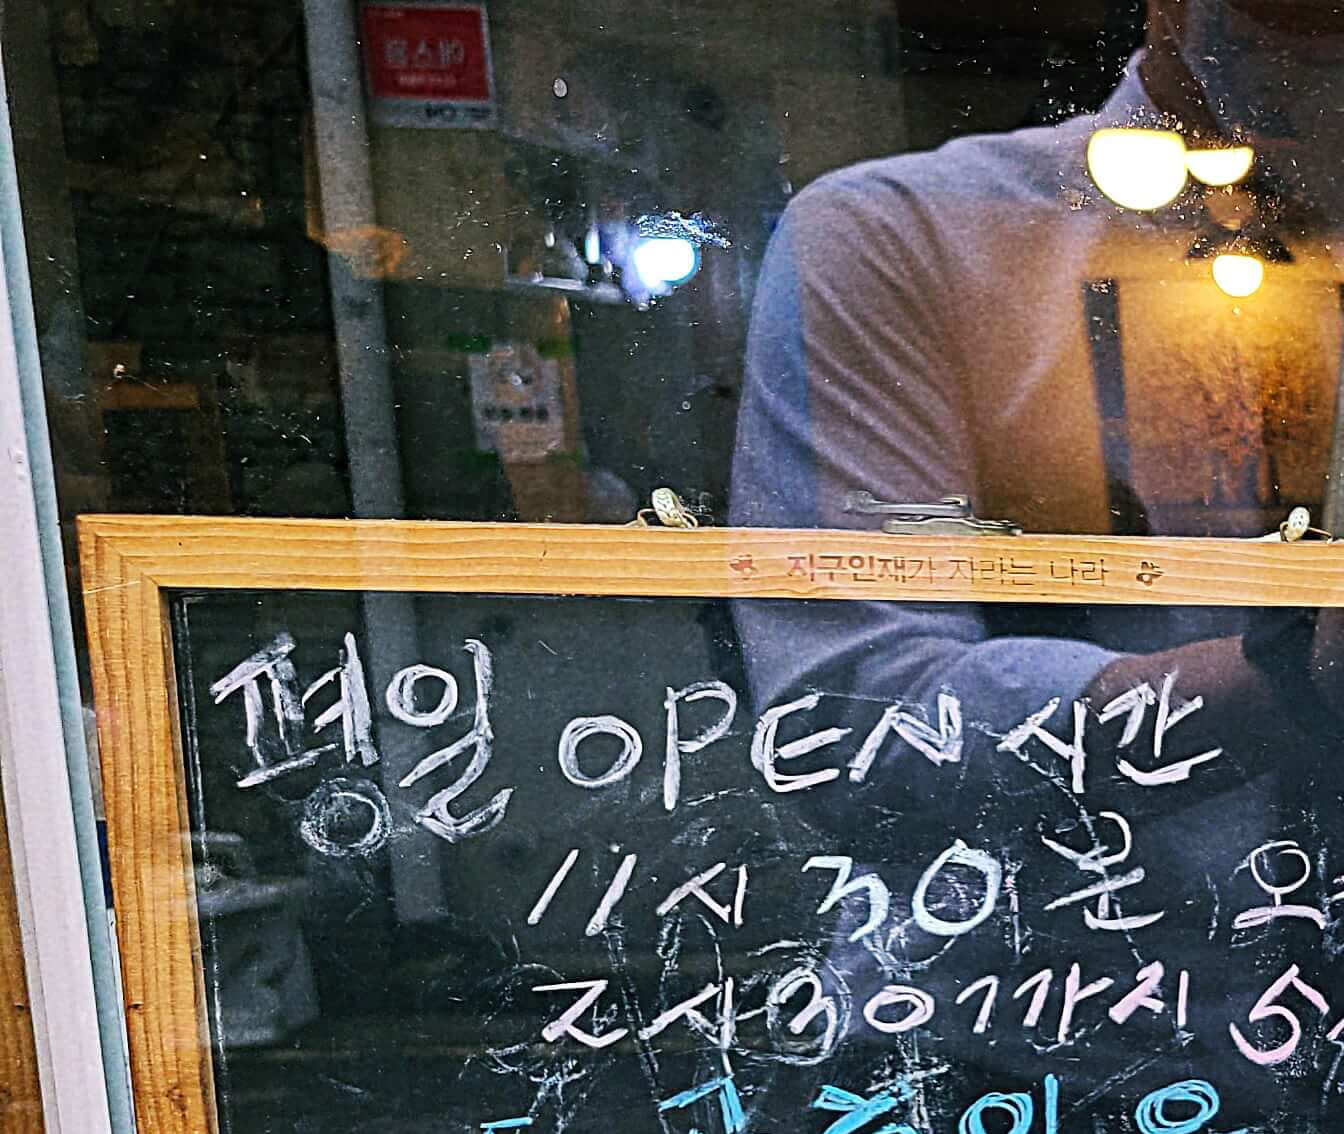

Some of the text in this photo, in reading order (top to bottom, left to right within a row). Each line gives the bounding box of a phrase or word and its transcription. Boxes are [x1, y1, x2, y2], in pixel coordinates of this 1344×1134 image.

[786, 555, 1109, 587] 지구인재가 자라는 나라
[210, 632, 1223, 860] 평일 OPEN 시간
